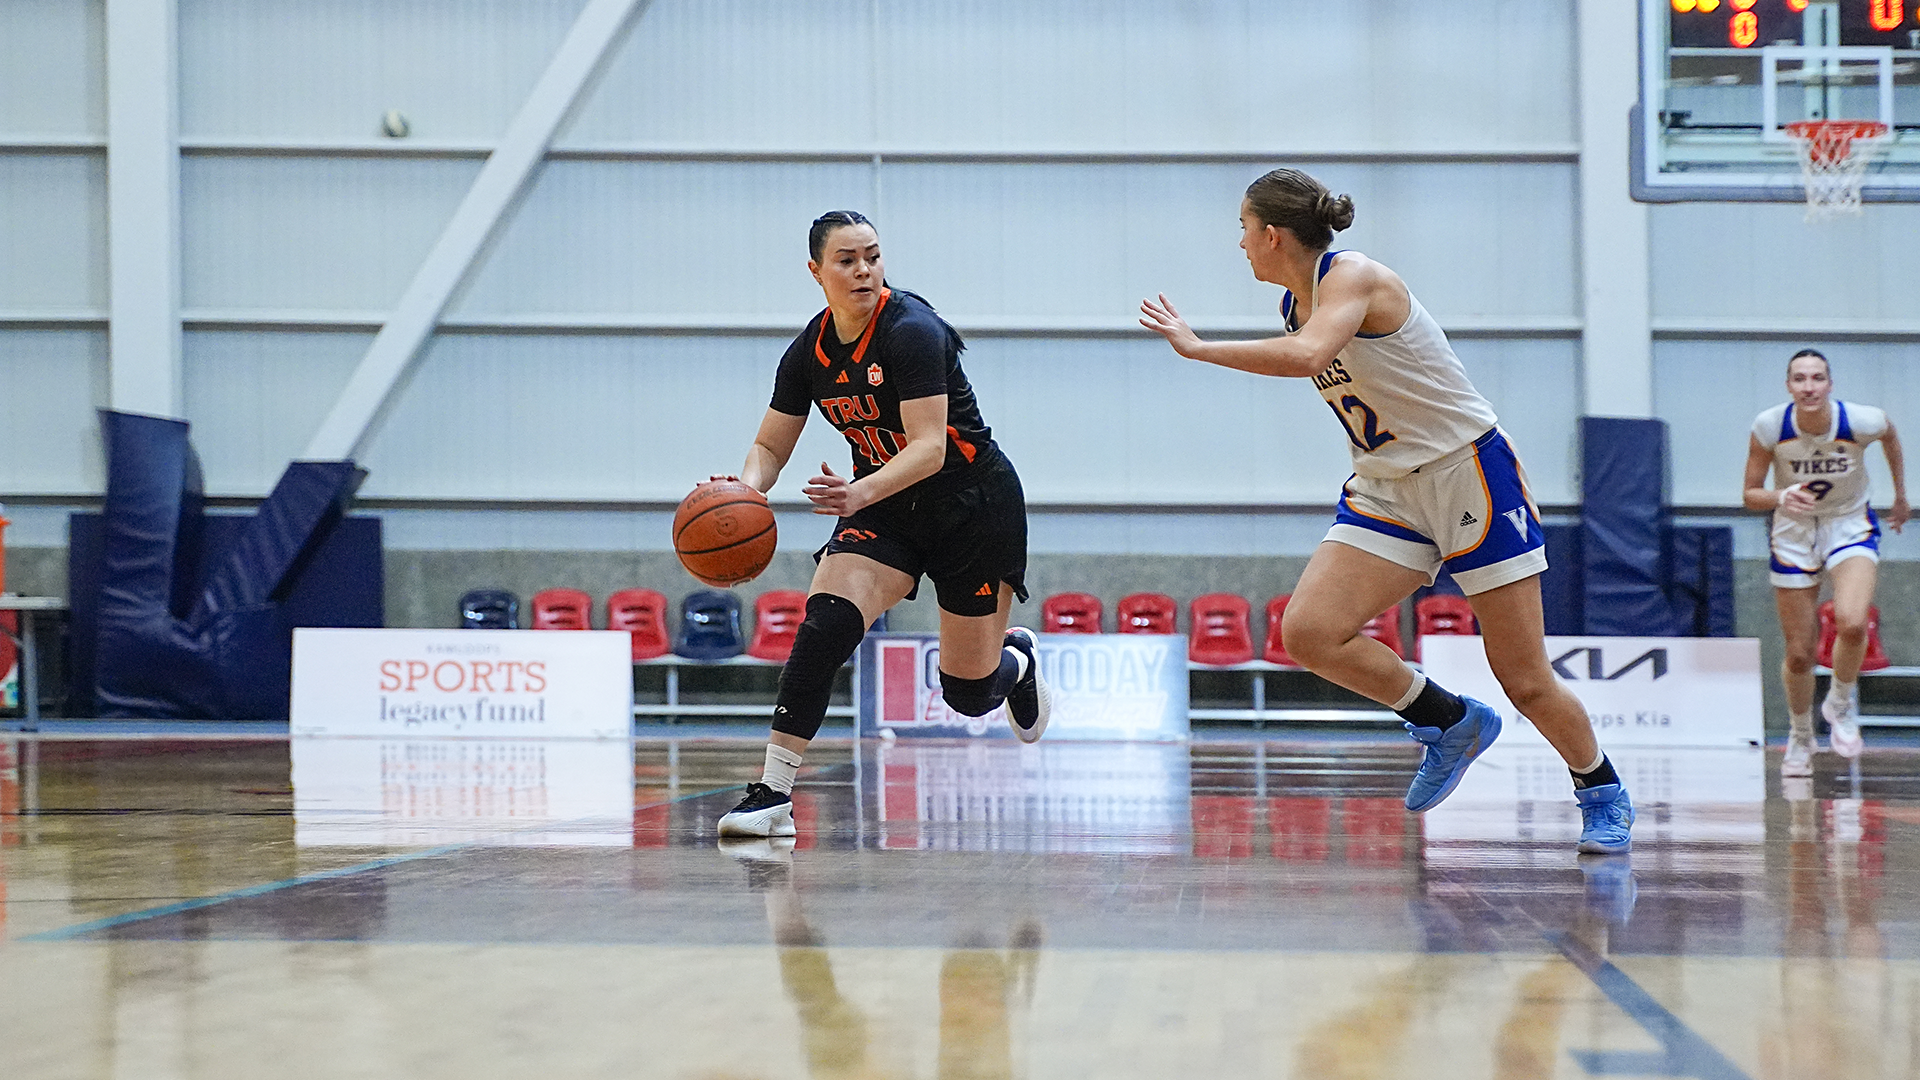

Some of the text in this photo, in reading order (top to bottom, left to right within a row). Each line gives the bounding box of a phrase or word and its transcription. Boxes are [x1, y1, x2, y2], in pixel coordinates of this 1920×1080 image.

[820, 394, 880, 424] TRU
[1326, 394, 1397, 452] 12
[1790, 457, 1849, 474] VIKES
[1806, 480, 1834, 500] 9
[379, 660, 547, 692] SPORTS
[1037, 648, 1164, 694] TODAY
[1635, 710, 1672, 727] Kia
